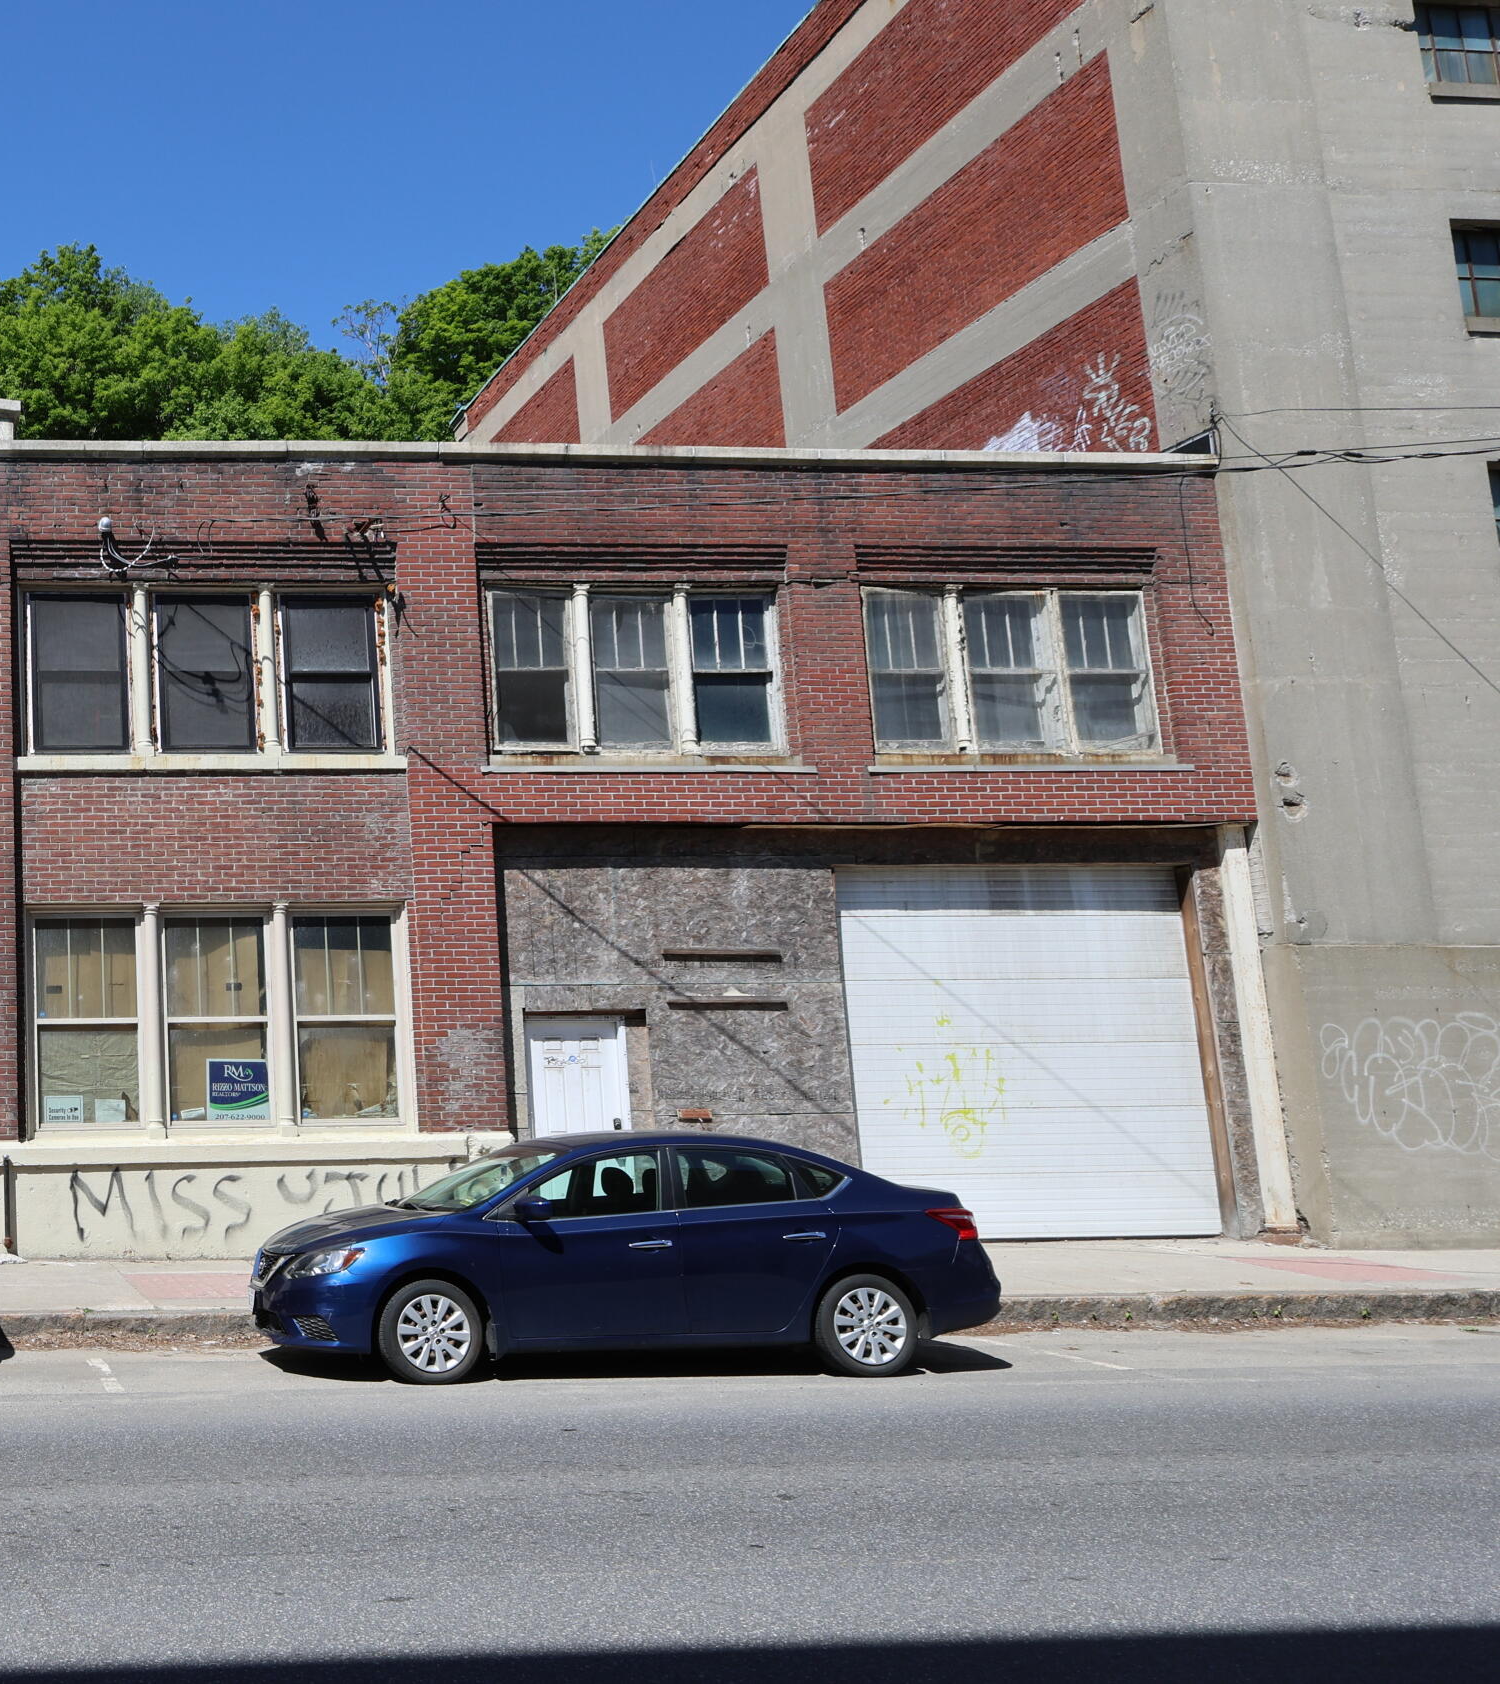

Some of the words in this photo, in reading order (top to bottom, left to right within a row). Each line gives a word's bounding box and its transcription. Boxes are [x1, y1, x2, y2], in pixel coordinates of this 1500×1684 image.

[211, 1083, 233, 1092] RIZZO
[234, 1083, 266, 1092] MATTSON
[70, 1166, 252, 1243] MISS
